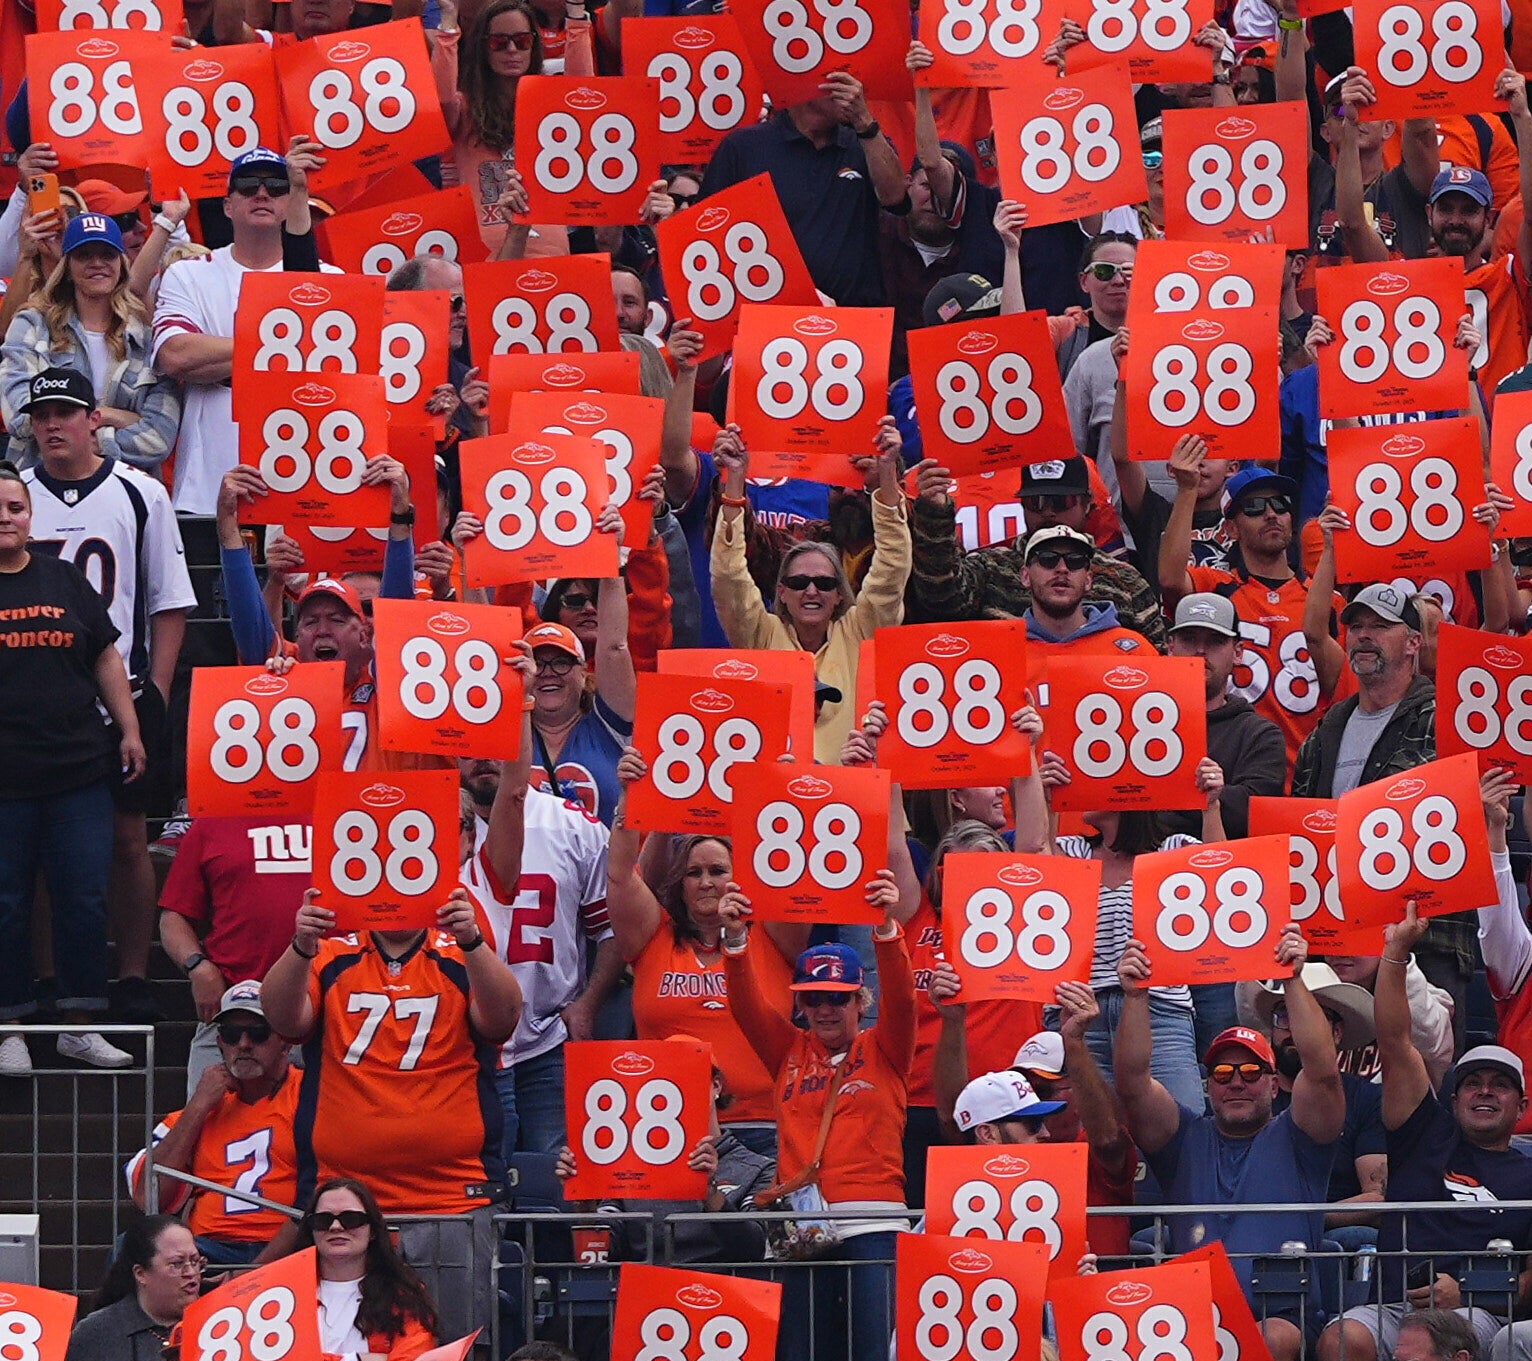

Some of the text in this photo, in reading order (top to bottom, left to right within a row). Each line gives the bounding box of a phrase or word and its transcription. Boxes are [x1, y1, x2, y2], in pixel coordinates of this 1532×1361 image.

[309, 57, 416, 149] 88
[82, 217, 105, 232] ny
[34, 378, 69, 393] Good
[936, 352, 1042, 443] 88
[0, 605, 65, 621] enver
[0, 630, 74, 649] roncos
[1229, 622, 1317, 714] 58
[210, 697, 319, 783] 88
[248, 824, 313, 873] ny
[753, 801, 863, 889] 88
[343, 993, 440, 1070] 77
[1237, 1030, 1256, 1041] LIX
